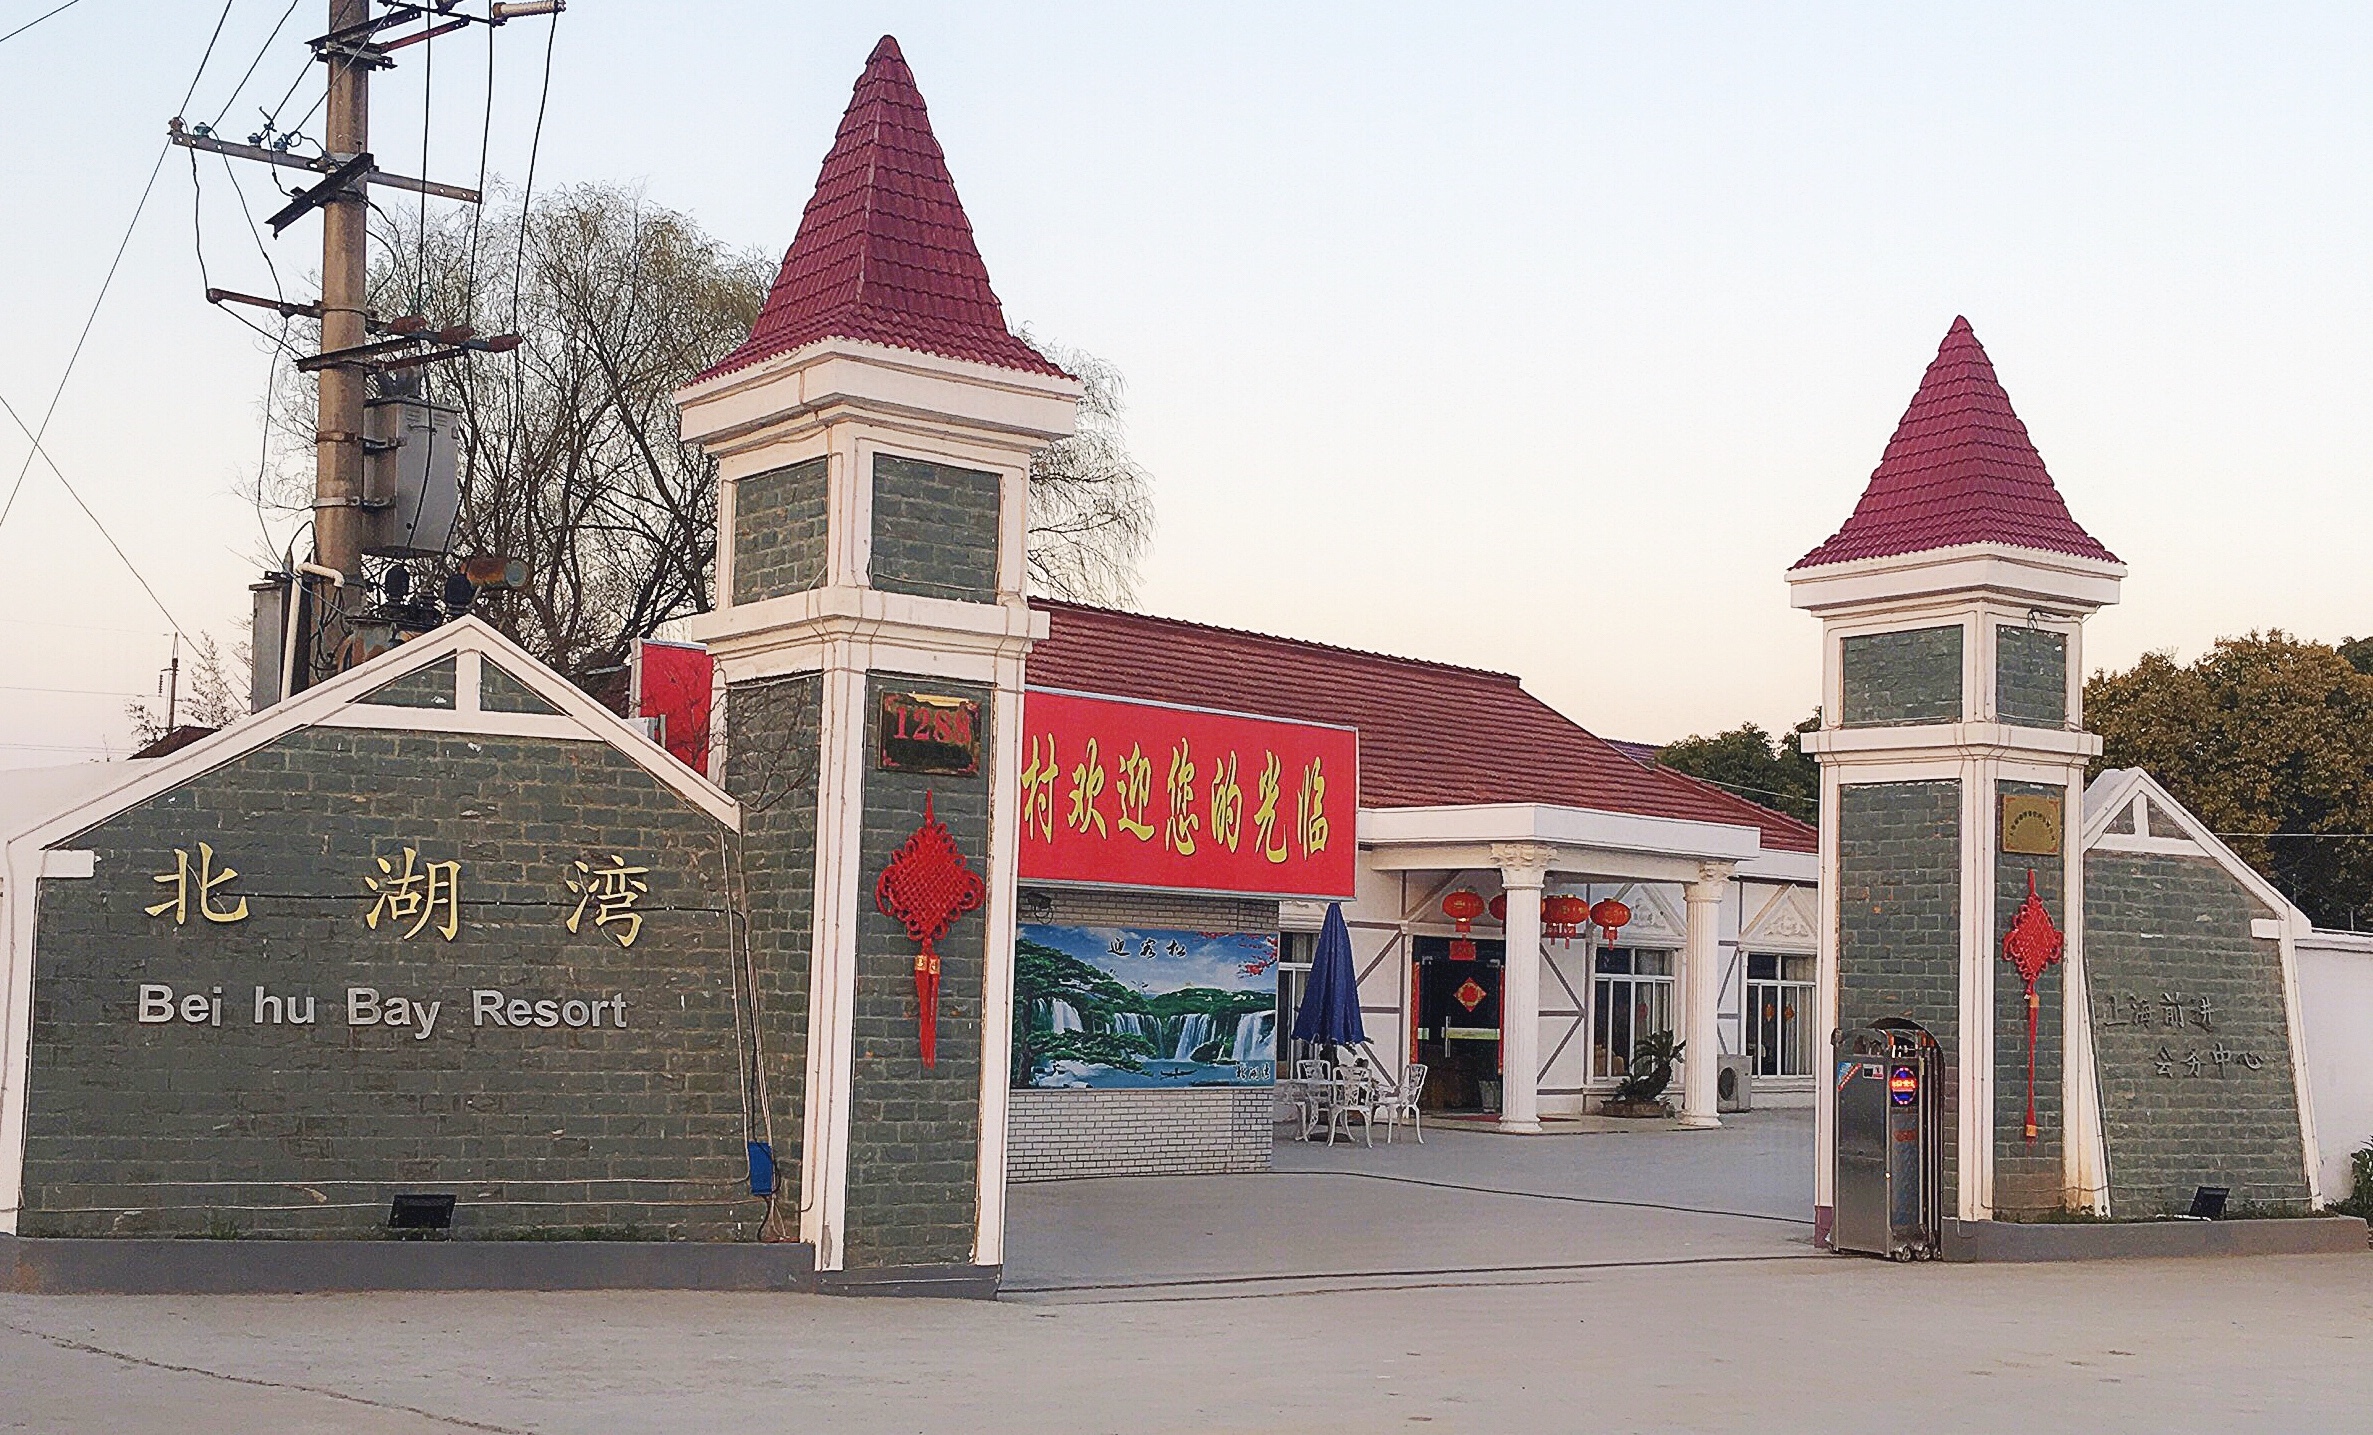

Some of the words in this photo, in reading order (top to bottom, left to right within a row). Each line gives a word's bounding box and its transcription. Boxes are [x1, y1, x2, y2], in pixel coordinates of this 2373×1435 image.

[893, 706, 971, 746] 1288
[1020, 732, 1330, 864] 村欢迎您的光临
[144, 841, 651, 949] 北湖湾
[1107, 937, 1187, 960] 迎客松
[137, 984, 223, 1027] Bei
[253, 985, 316, 1025] hu
[347, 987, 442, 1041] Bay
[472, 988, 629, 1029] Resort
[2103, 991, 2215, 1034] 上海前进
[2154, 1042, 2264, 1079] 会务中心
